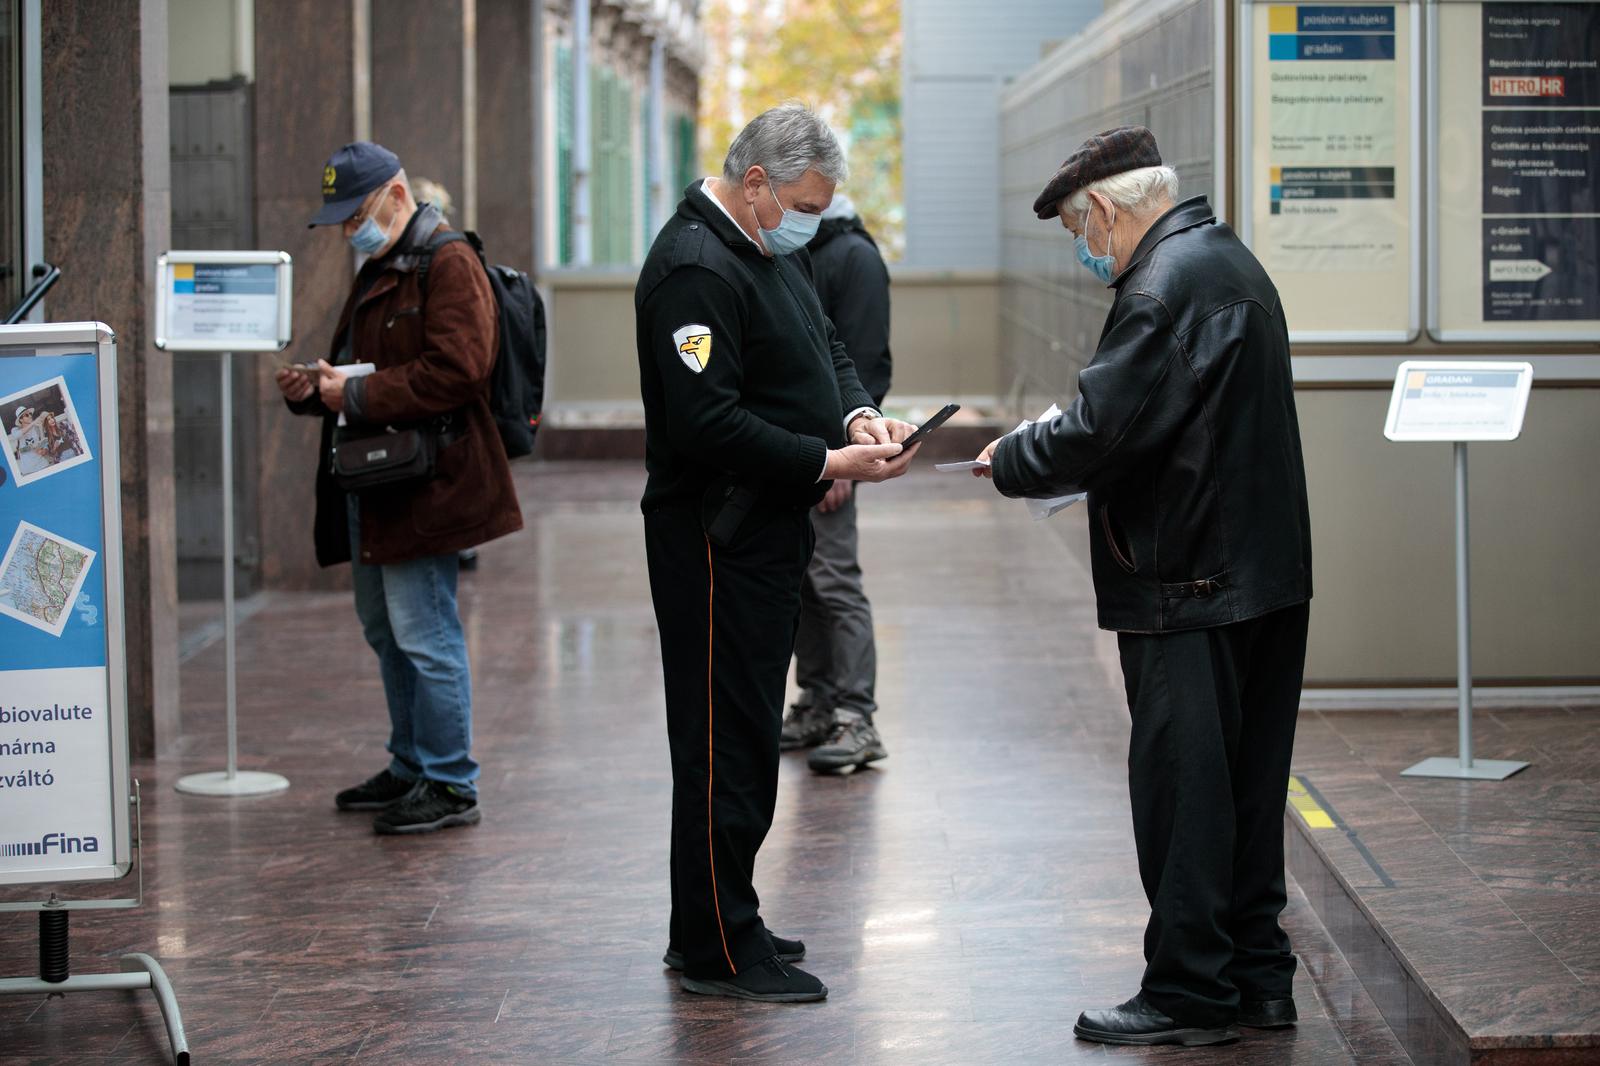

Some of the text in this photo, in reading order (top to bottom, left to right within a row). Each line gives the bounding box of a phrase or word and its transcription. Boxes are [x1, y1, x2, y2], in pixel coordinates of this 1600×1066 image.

[1303, 13, 1388, 26] poslovni subjekti
[1546, 59, 1568, 69] platni
[1569, 59, 1597, 69] promet
[0, 703, 93, 724] biovalute
[42, 832, 99, 855] Fina
